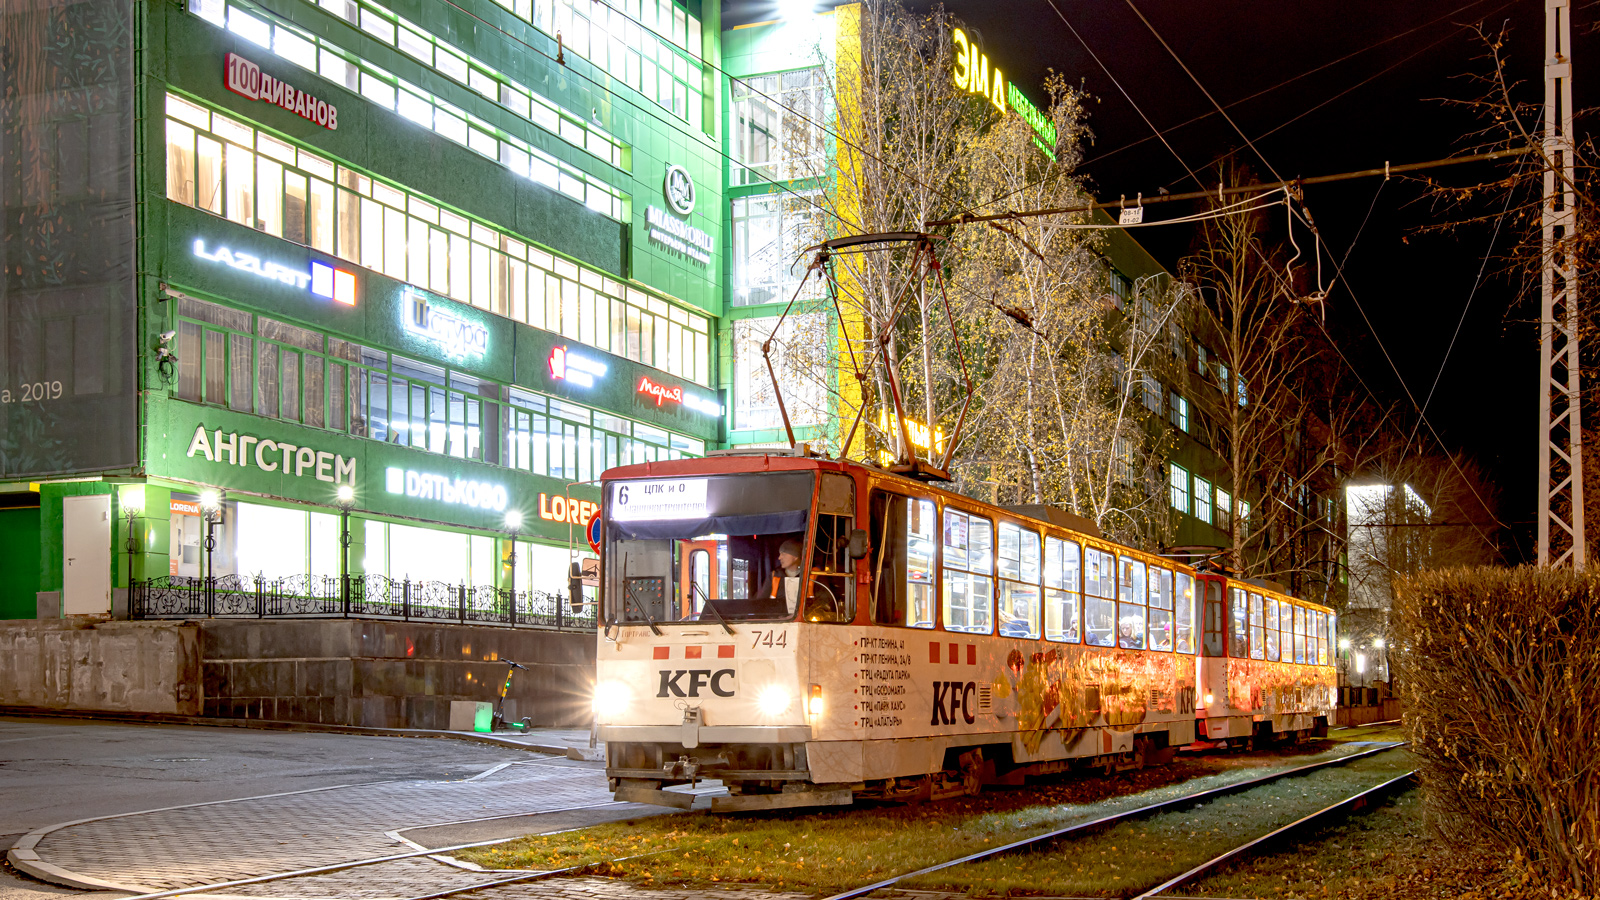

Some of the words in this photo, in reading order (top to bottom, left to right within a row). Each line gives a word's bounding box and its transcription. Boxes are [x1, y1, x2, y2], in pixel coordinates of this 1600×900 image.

[260, 72, 338, 130] ДИВАНОВ
[193, 239, 312, 289] LAZURIT
[21, 380, 63, 402] 2019
[639, 377, 683, 406] Мария
[187, 427, 356, 485] АНГСТРЕМ
[618, 485, 629, 505] 6
[644, 484, 664, 495] ЦПК
[170, 502, 199, 513] LORENA
[751, 630, 787, 649] 744
[657, 668, 735, 698] KFC
[860, 669, 873, 681] ТРЦ
[860, 685, 873, 697] ТРЦ
[860, 701, 873, 713] ТРЦ
[931, 681, 975, 726] KFC
[860, 717, 873, 729] ТРЦ
